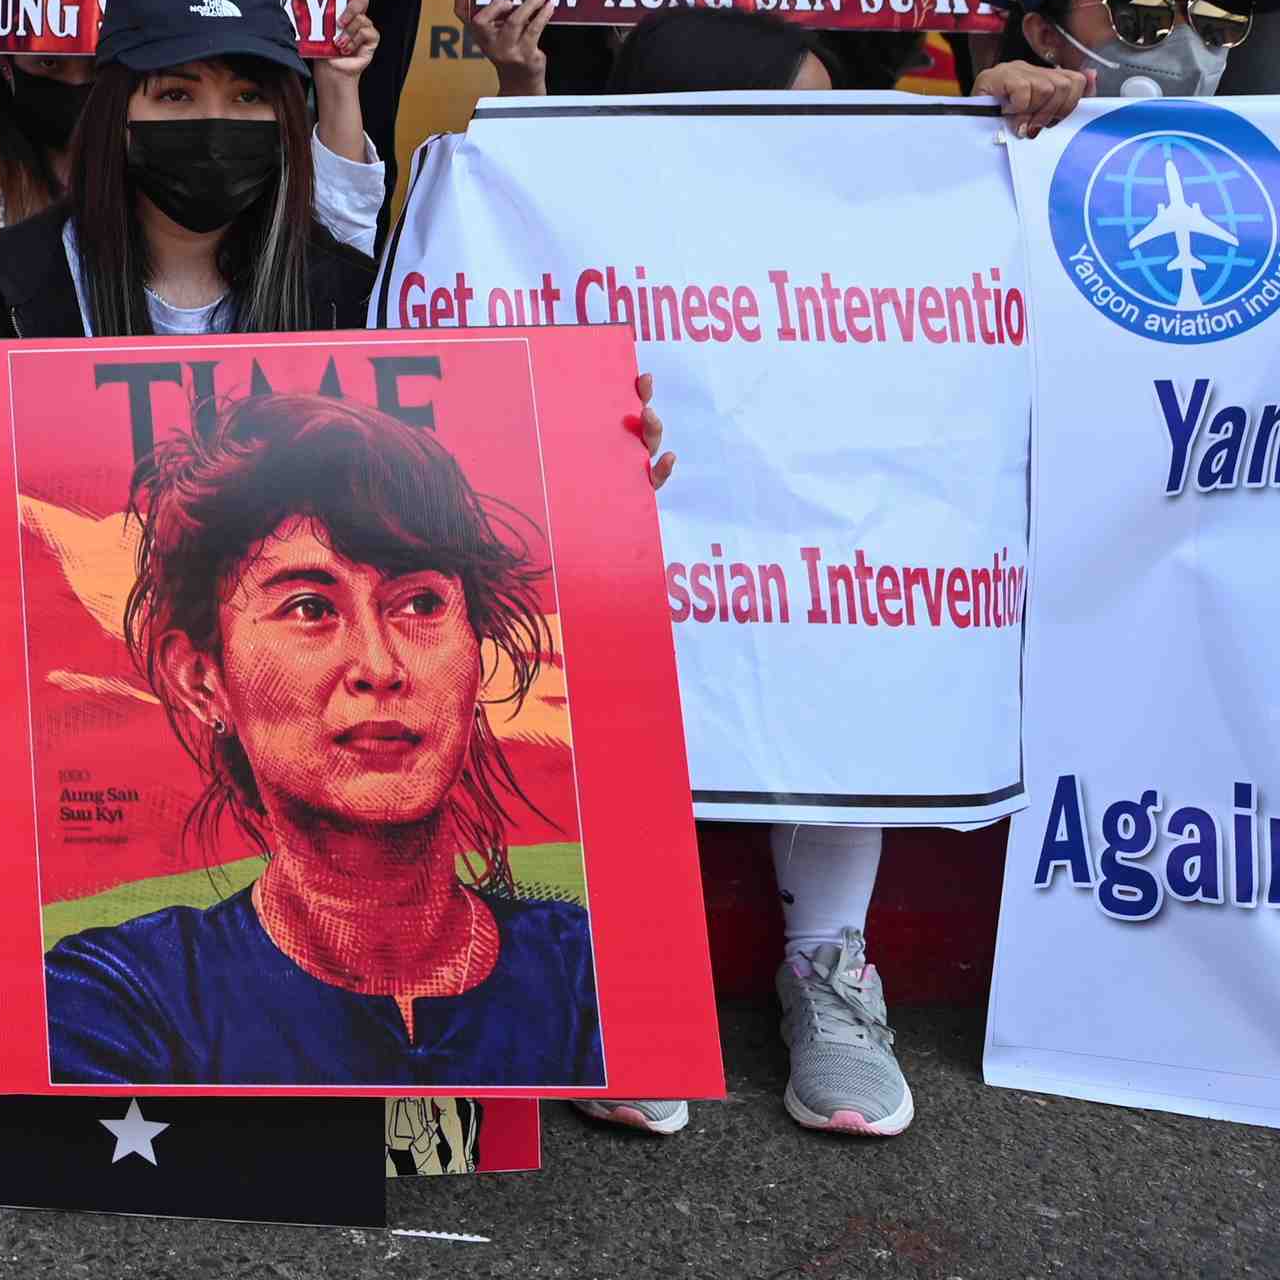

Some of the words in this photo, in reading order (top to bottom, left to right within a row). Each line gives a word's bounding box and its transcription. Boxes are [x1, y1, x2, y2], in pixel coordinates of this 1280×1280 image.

[398, 270, 474, 328] Get
[488, 272, 561, 325] out
[575, 265, 762, 343] Chinese
[768, 267, 1028, 347] Interventio
[1069, 242, 1140, 323] Yangon
[1144, 307, 1242, 337] aviation
[94, 356, 443, 477] TIE
[669, 543, 788, 626] ssian
